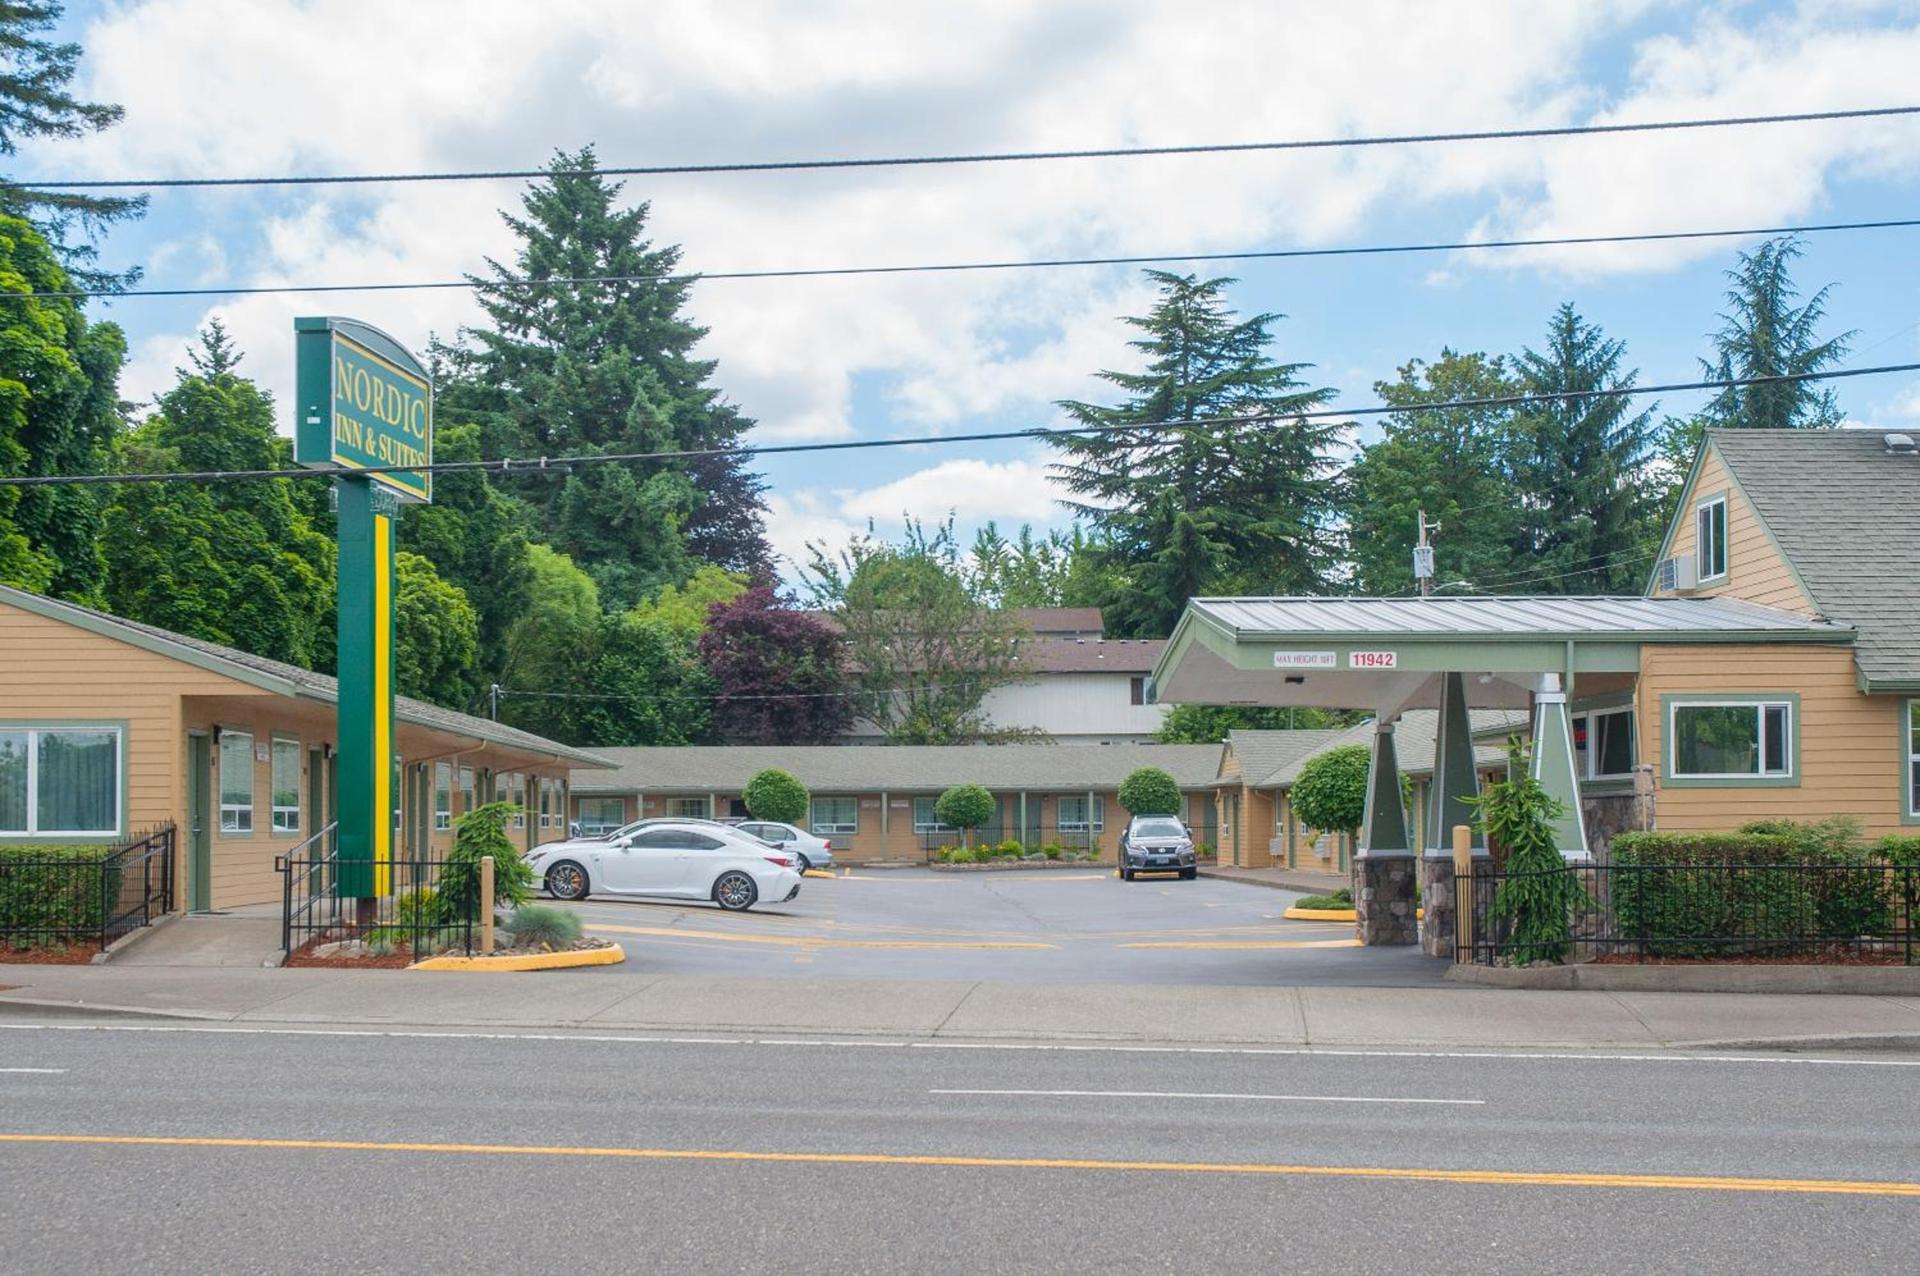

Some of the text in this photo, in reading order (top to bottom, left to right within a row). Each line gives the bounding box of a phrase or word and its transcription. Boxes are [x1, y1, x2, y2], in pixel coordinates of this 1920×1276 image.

[336, 357, 425, 439] NORDIC
[336, 412, 425, 477] INN & SUITES
[1354, 653, 1393, 666] 11942
